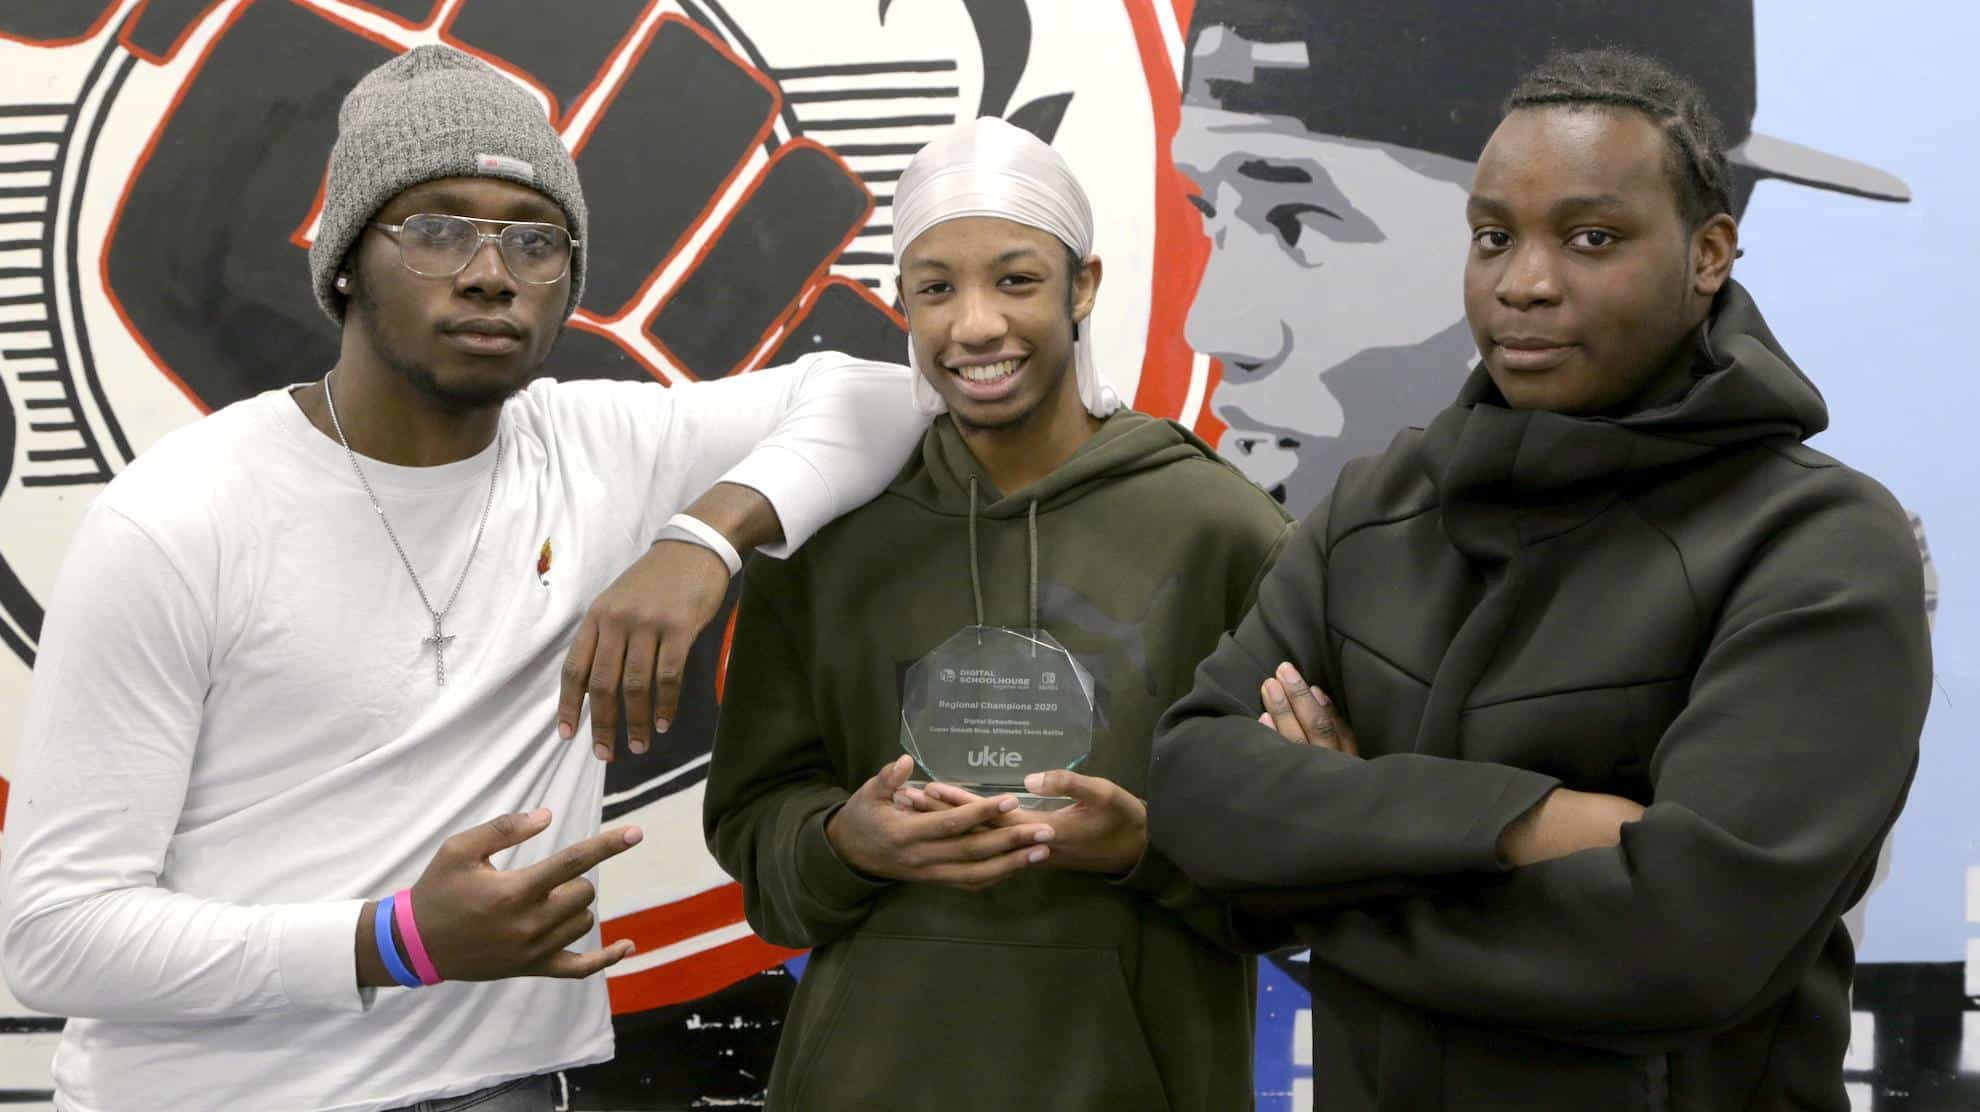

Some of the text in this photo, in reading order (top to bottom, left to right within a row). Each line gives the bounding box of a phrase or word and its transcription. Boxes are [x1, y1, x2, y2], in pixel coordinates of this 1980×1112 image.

[938, 700, 1058, 712] Regional Champions 2020
[968, 745, 1023, 768] ukie
